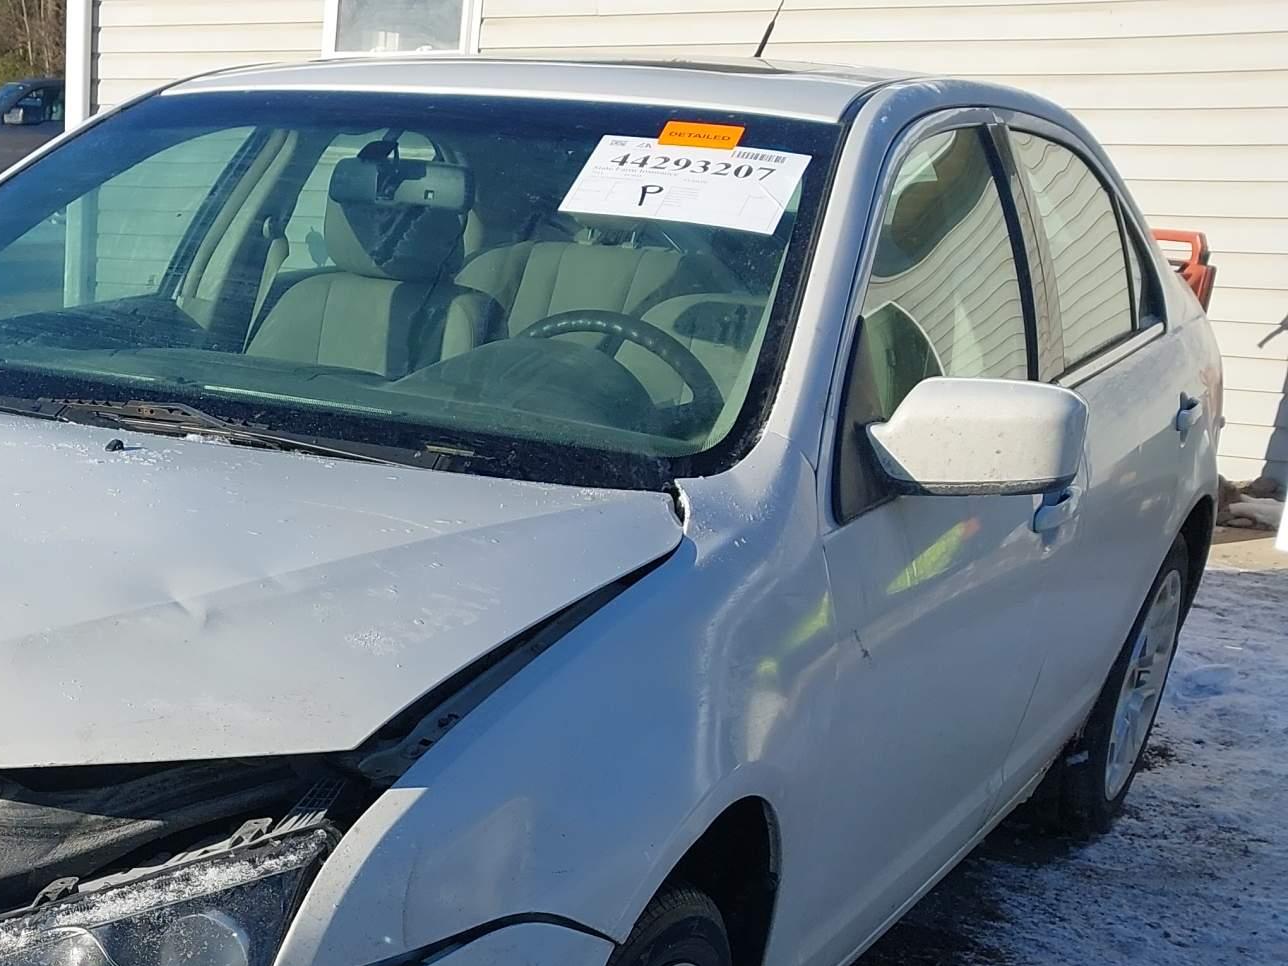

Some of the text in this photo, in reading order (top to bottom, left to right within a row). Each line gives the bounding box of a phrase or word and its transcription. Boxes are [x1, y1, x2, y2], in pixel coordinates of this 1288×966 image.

[668, 131, 732, 142] DETAILED
[611, 153, 776, 181] 44293207
[638, 184, 664, 207] P
